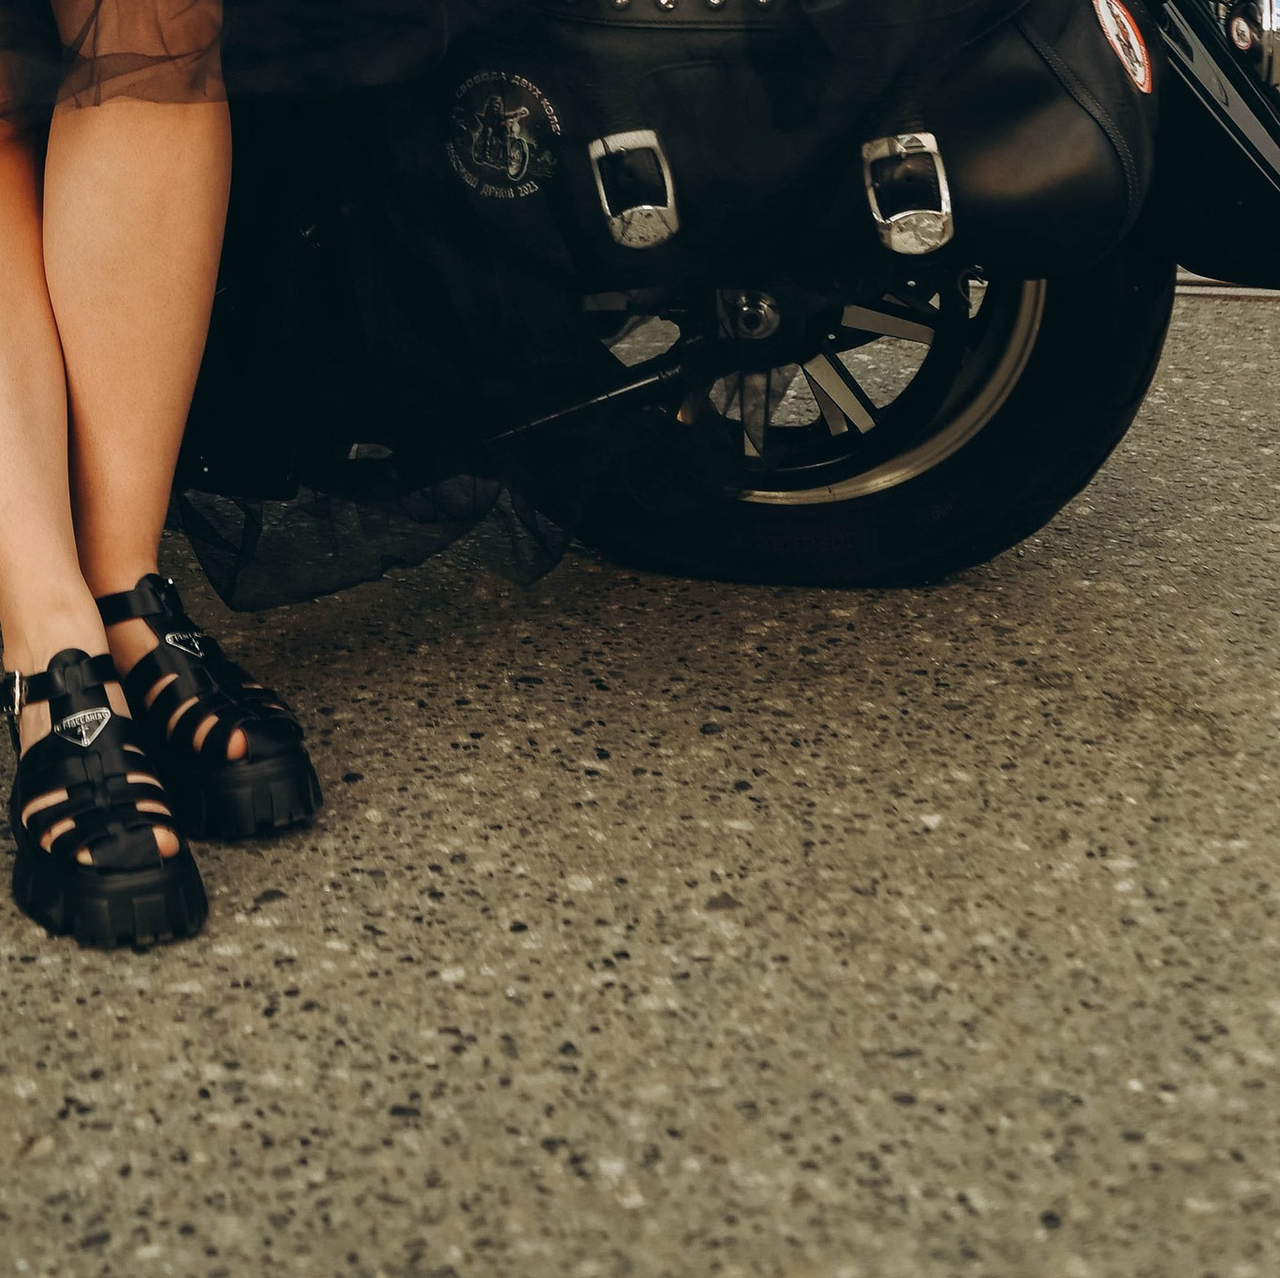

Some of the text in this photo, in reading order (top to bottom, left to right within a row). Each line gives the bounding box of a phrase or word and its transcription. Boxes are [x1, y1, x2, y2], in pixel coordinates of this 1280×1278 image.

[510, 74, 542, 98] ДВУХ
[541, 97, 561, 136] КОЛЕ
[518, 181, 539, 197] 2023
